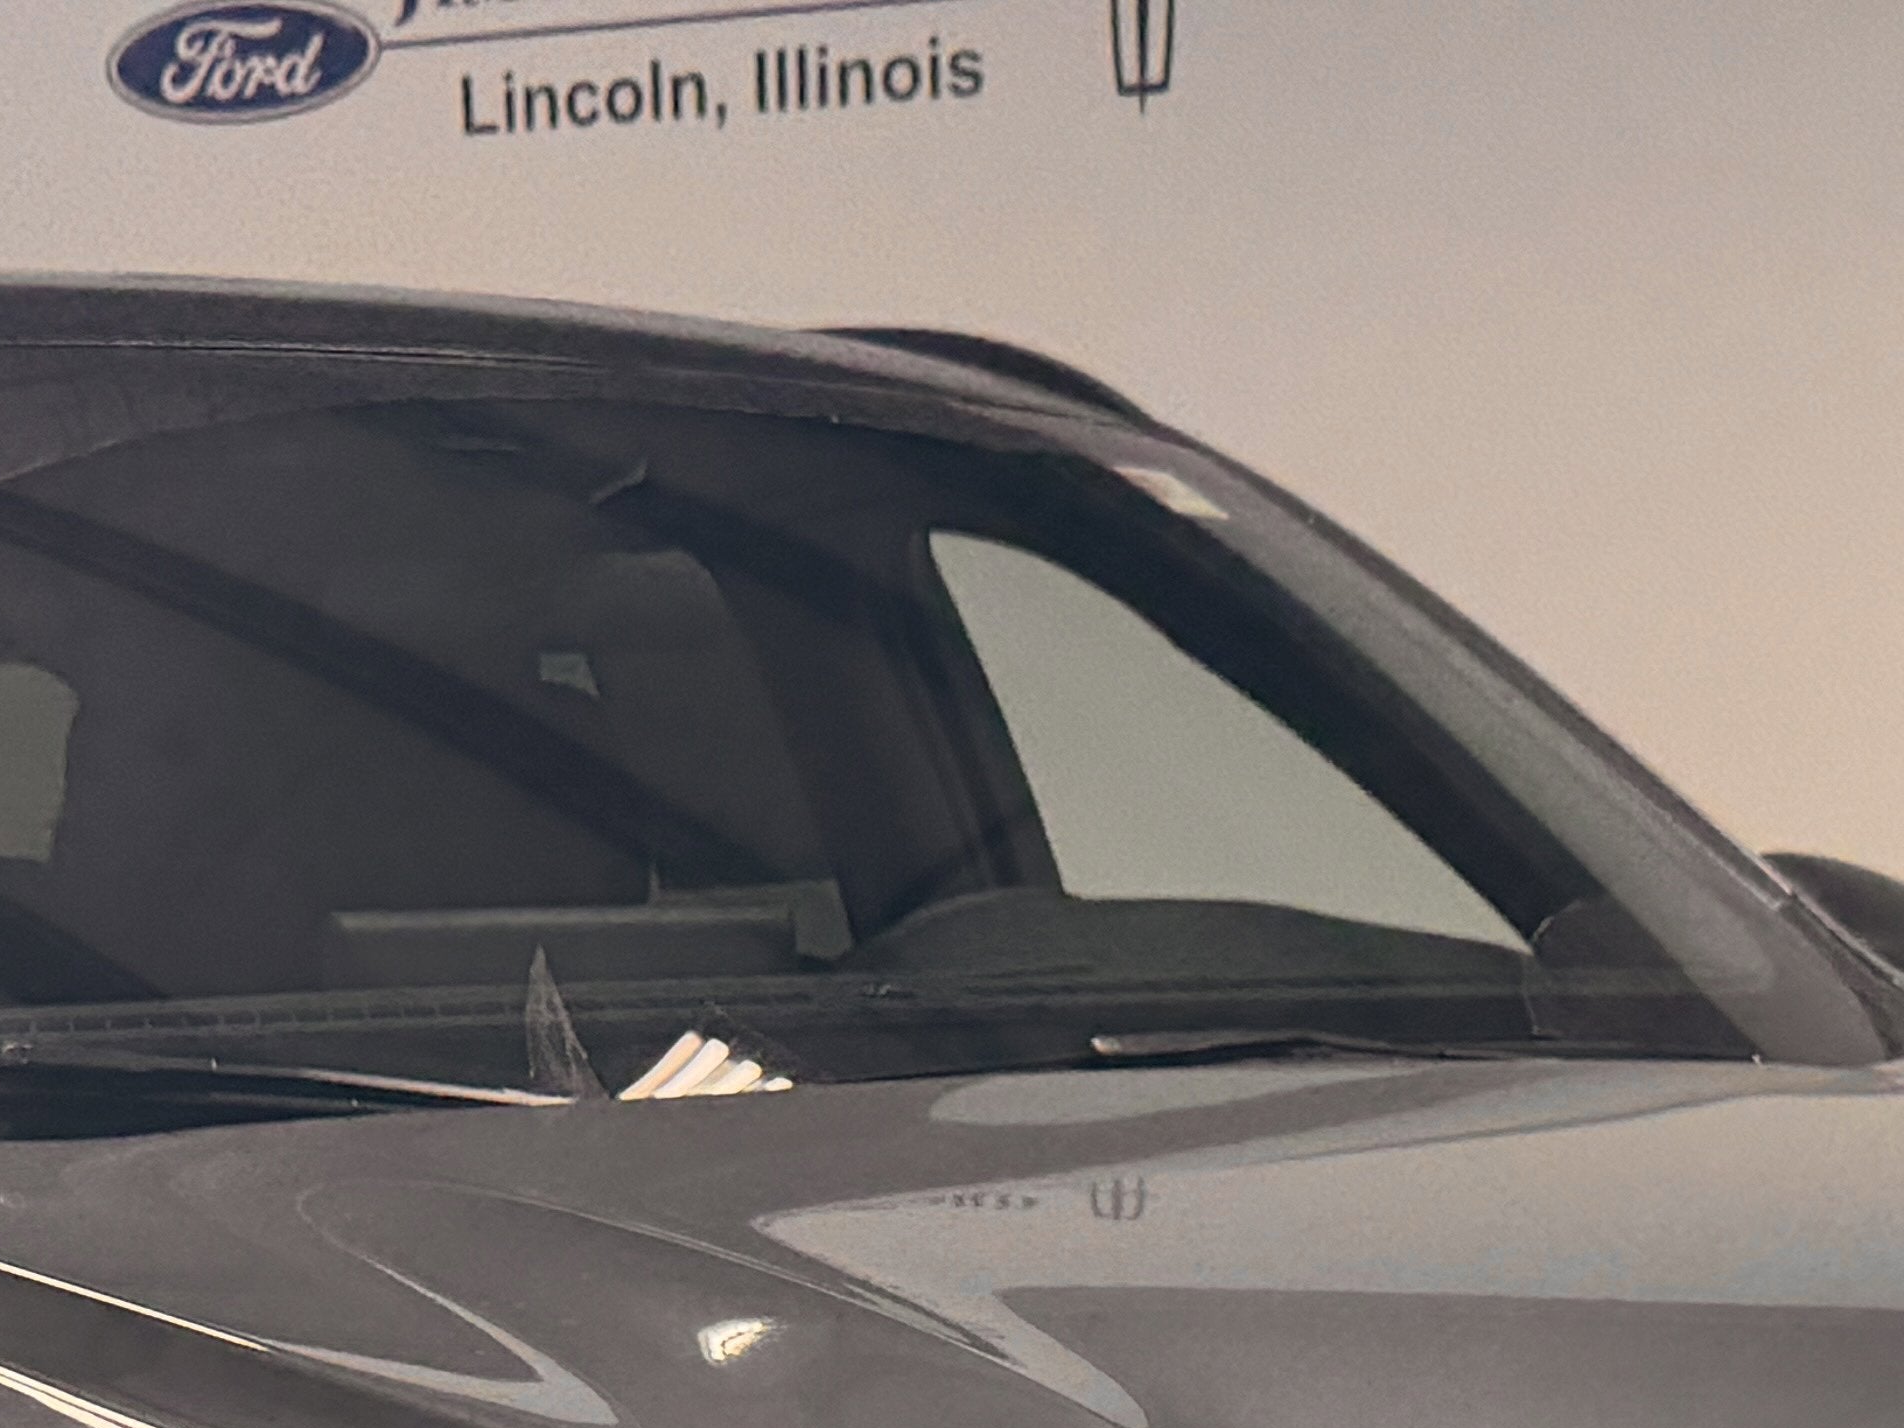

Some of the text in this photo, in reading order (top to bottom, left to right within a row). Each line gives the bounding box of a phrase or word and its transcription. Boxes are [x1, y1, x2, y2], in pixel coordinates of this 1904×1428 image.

[160, 17, 323, 104] Ford
[460, 36, 986, 137] Lincoln, Illinois
